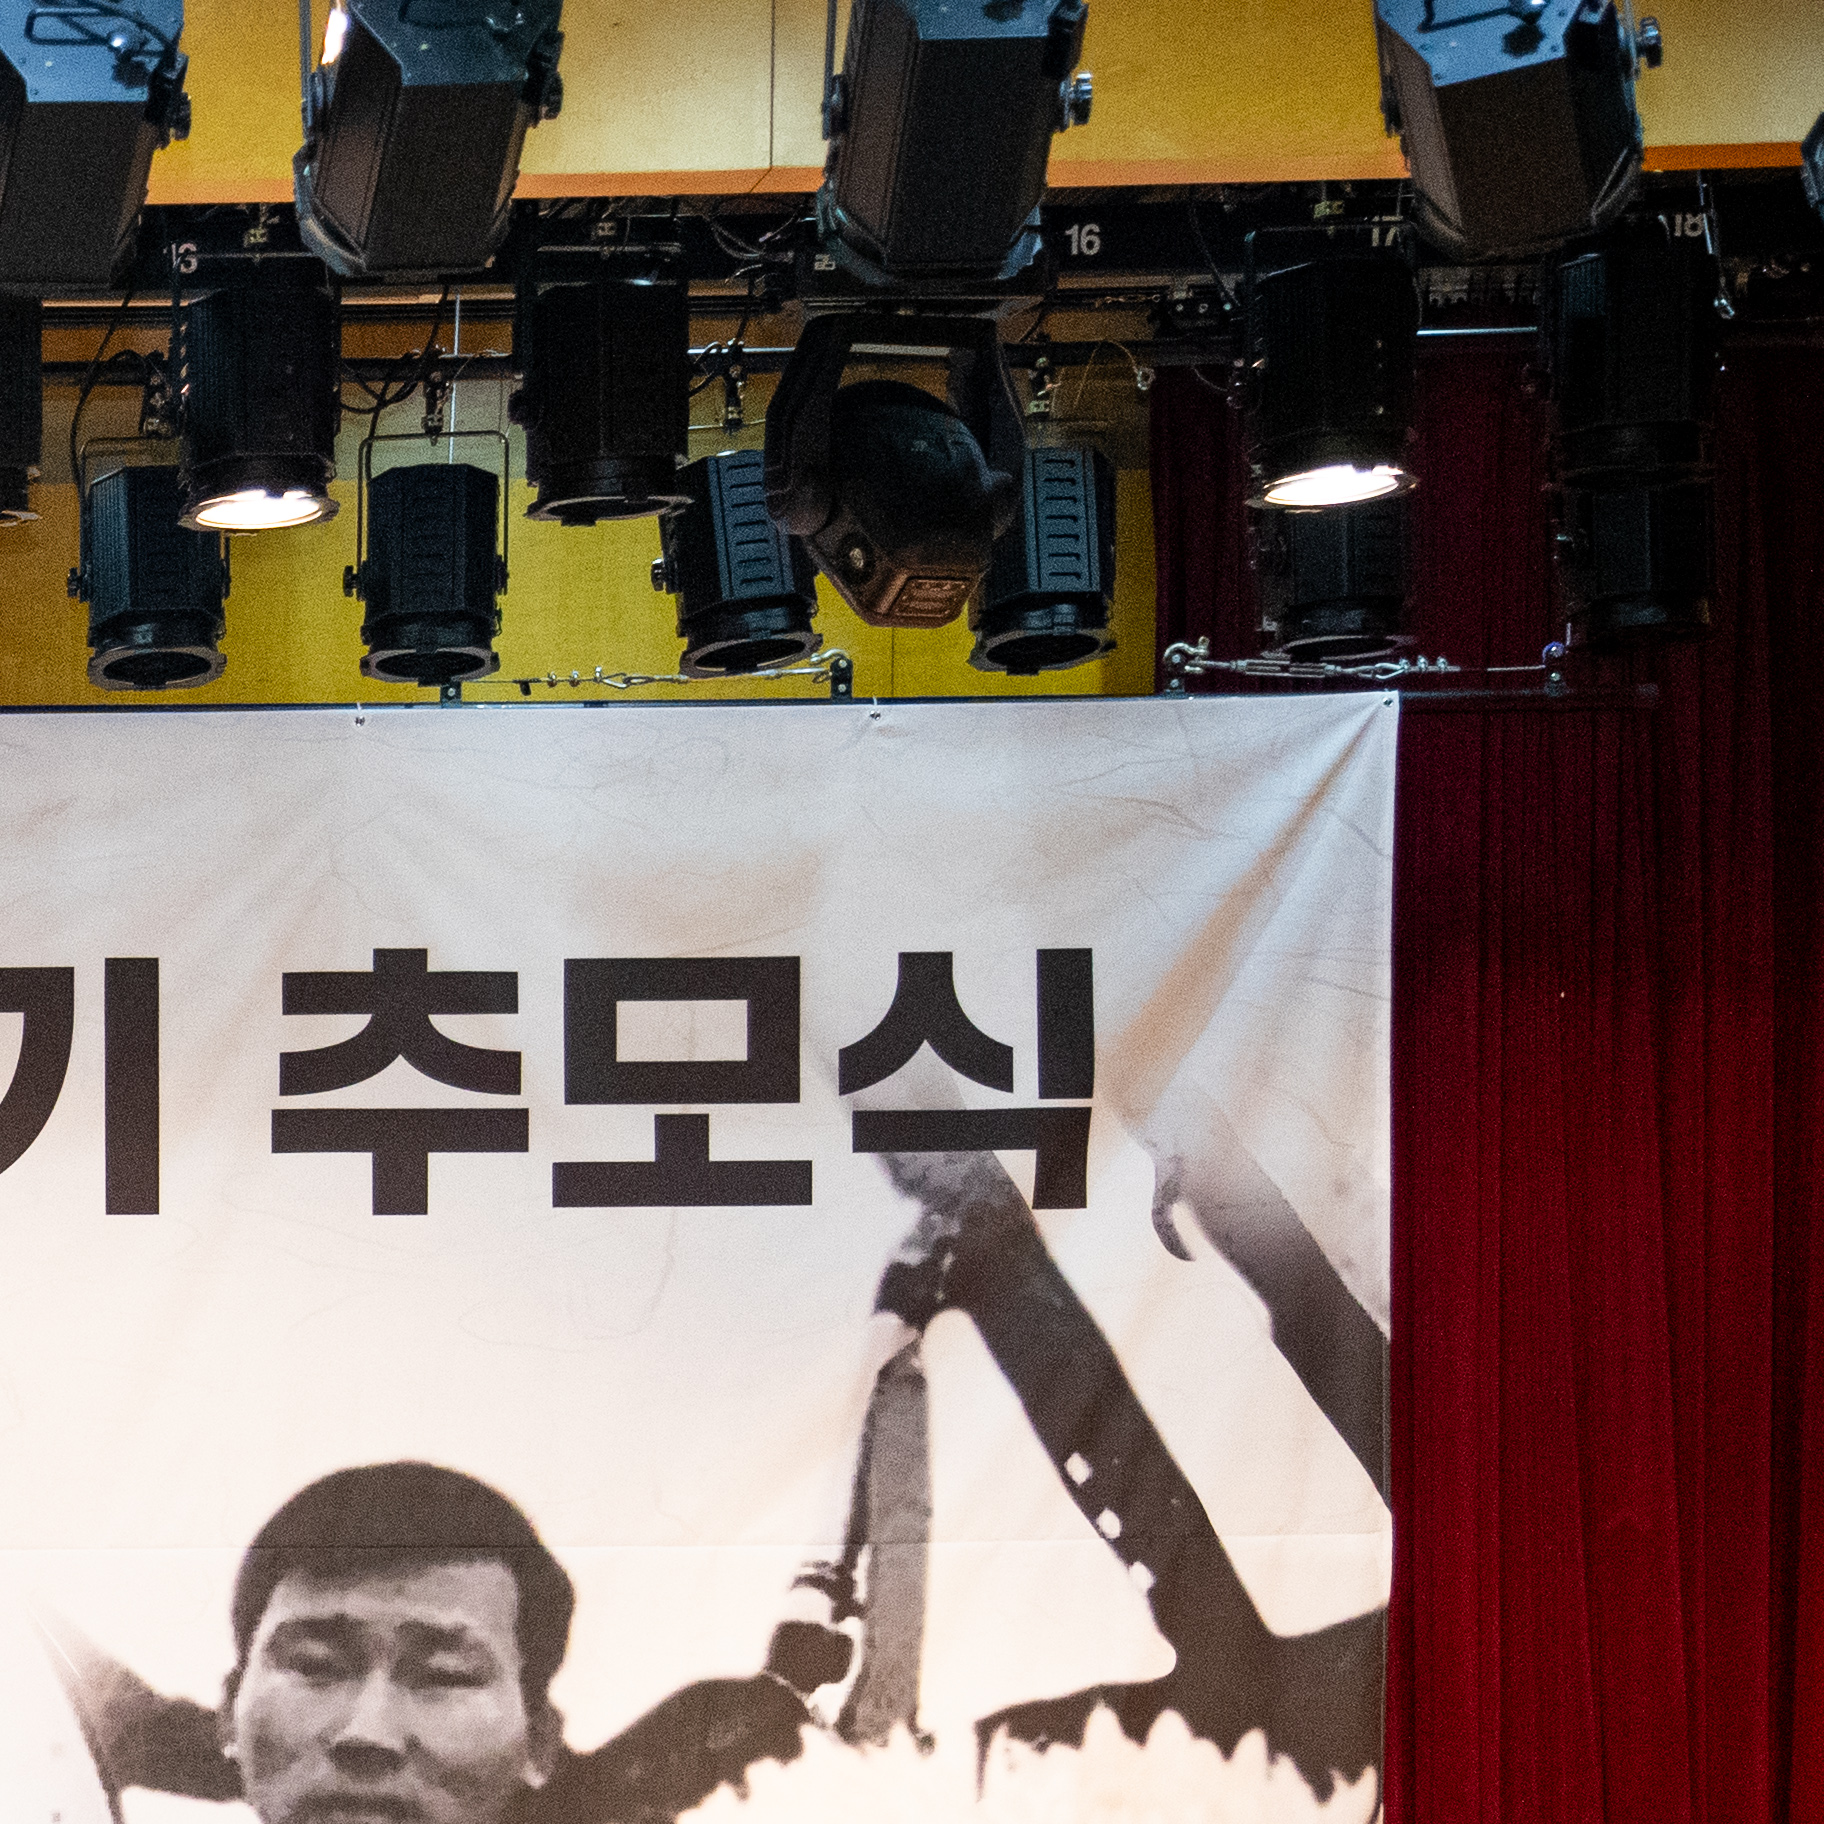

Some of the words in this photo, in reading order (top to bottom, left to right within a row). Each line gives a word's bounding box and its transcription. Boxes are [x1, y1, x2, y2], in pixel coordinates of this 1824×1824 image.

[1065, 223, 1101, 256] 16
[1371, 215, 1404, 247] 17
[272, 949, 1094, 1209] 추모식
